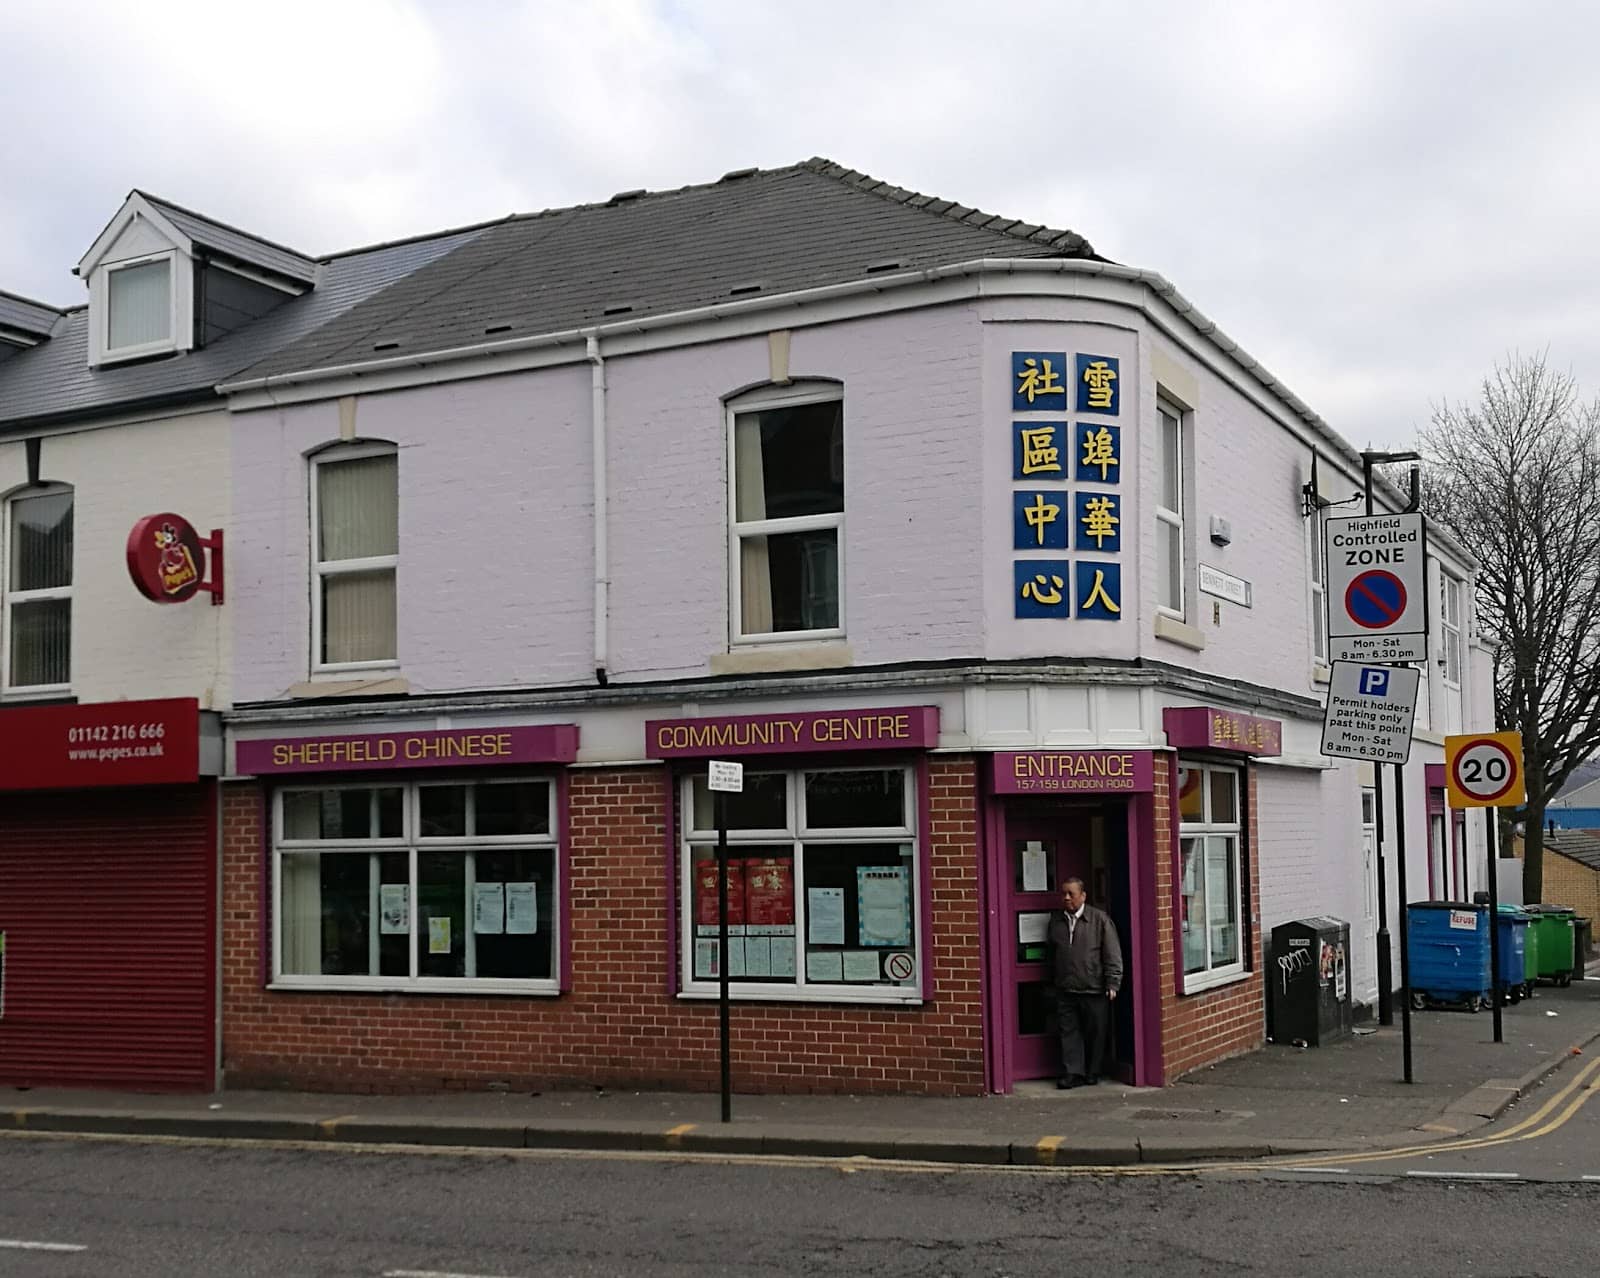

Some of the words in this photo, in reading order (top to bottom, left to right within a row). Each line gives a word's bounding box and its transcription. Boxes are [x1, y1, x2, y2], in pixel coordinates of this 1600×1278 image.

[1018, 359, 1065, 605] 社區中心
[1081, 361, 1121, 614] 雪埠華人
[1348, 519, 1401, 532] Highfield
[1333, 530, 1416, 547] Controlled
[1346, 548, 1405, 566] ZONE
[1353, 639, 1375, 648] Mon
[1383, 638, 1401, 647] Sat
[1365, 671, 1385, 693] P
[1333, 696, 1368, 708] Permit
[1371, 701, 1410, 713] holders
[1336, 709, 1377, 721] parking
[1380, 713, 1403, 724] only
[69, 726, 108, 742] 01142
[112, 724, 136, 740] 216
[139, 723, 165, 738] 666
[657, 720, 804, 749] COMMUNITY
[812, 715, 910, 742] CENTRE
[1329, 718, 1353, 728] past
[1356, 720, 1376, 731] this
[1379, 724, 1408, 735] point
[1342, 731, 1365, 742] Mon
[1373, 735, 1392, 746] Sat
[69, 742, 164, 762] www.pepes.co.uk
[272, 739, 397, 765] SHEFFIELD
[405, 733, 513, 760] CHINESE
[1014, 755, 1134, 777] ENTRANCE
[1462, 757, 1507, 783] 20
[1016, 779, 1059, 790] 157-159
[1061, 779, 1104, 789] LONDON
[1106, 779, 1134, 789] ROAD
[1451, 914, 1476, 926] REFUSE
